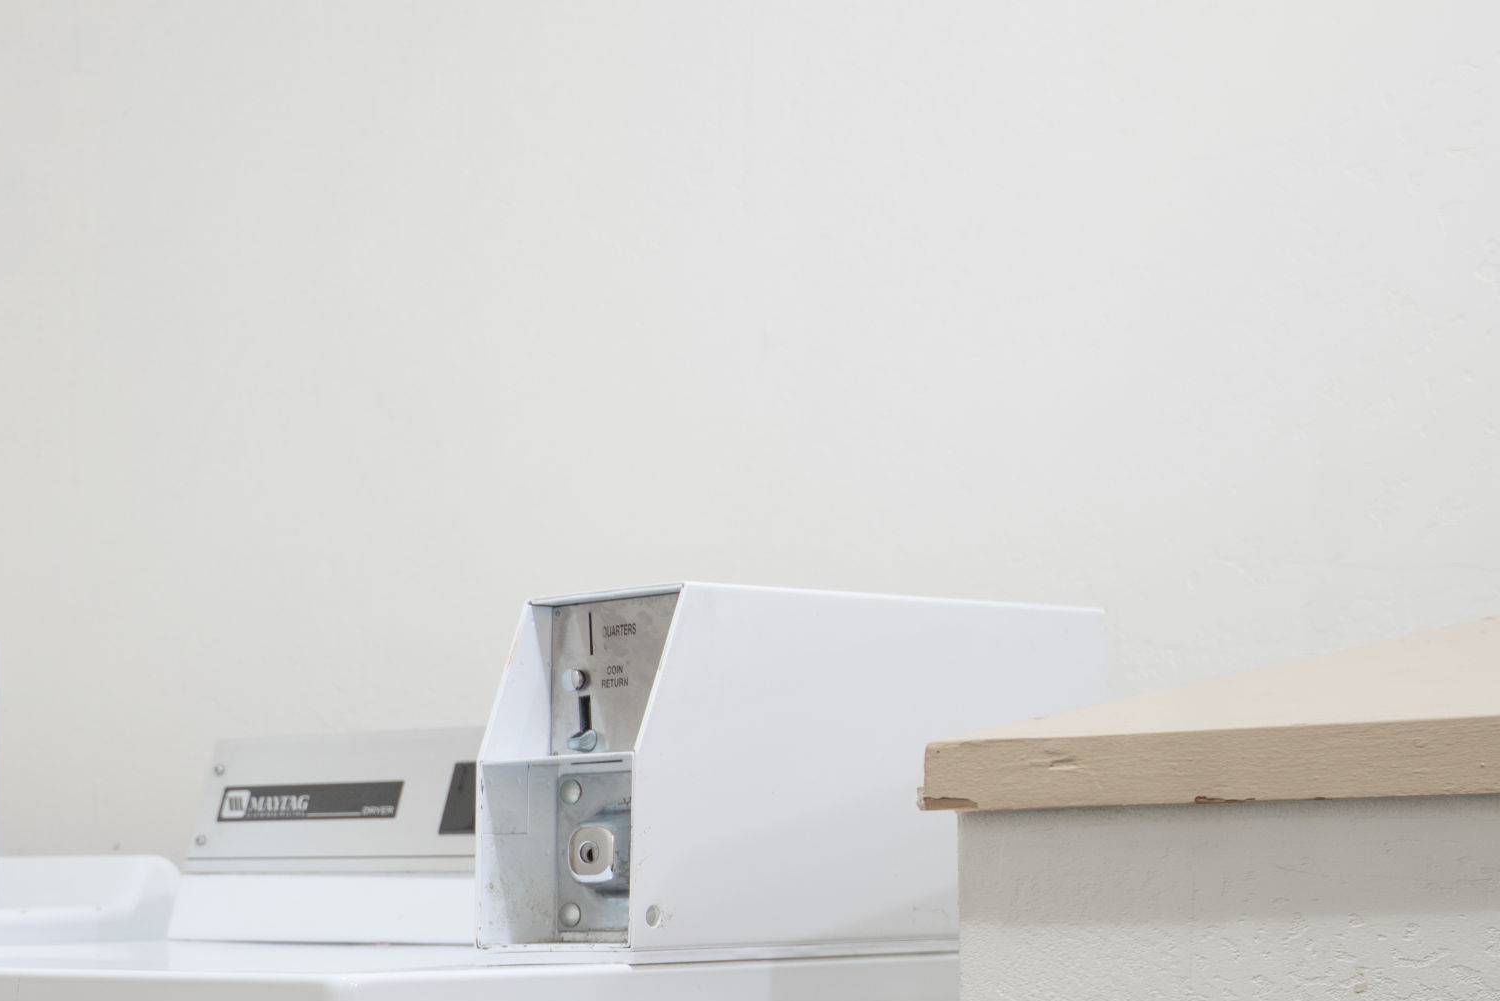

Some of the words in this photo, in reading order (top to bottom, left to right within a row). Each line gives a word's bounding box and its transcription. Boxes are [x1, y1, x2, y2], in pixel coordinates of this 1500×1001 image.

[602, 623, 637, 638] QUARTERS
[606, 665, 624, 675] COIN
[601, 677, 629, 688] RETURN
[248, 795, 310, 812] MAYTAG
